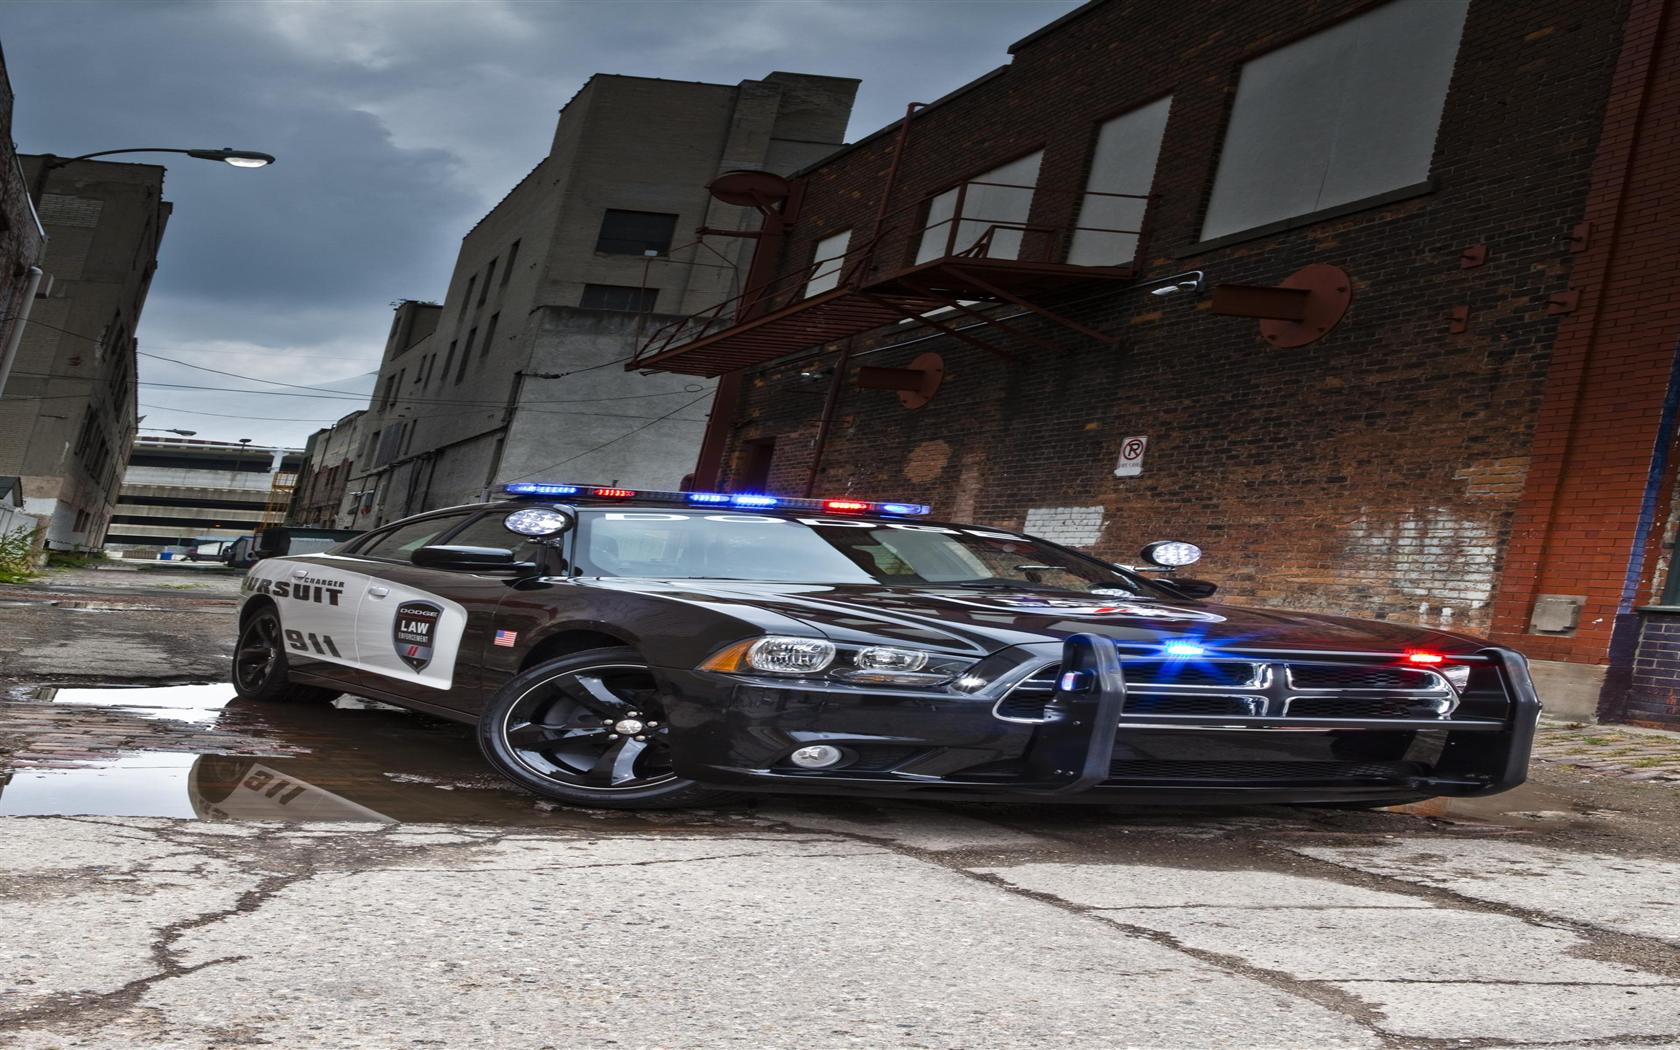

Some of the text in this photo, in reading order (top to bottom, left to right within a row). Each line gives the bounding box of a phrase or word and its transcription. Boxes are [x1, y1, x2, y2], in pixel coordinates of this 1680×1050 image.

[303, 577, 345, 588] CHARGER
[400, 608, 438, 617] DODGE
[401, 620, 429, 634] LAW
[285, 629, 342, 658] 911
